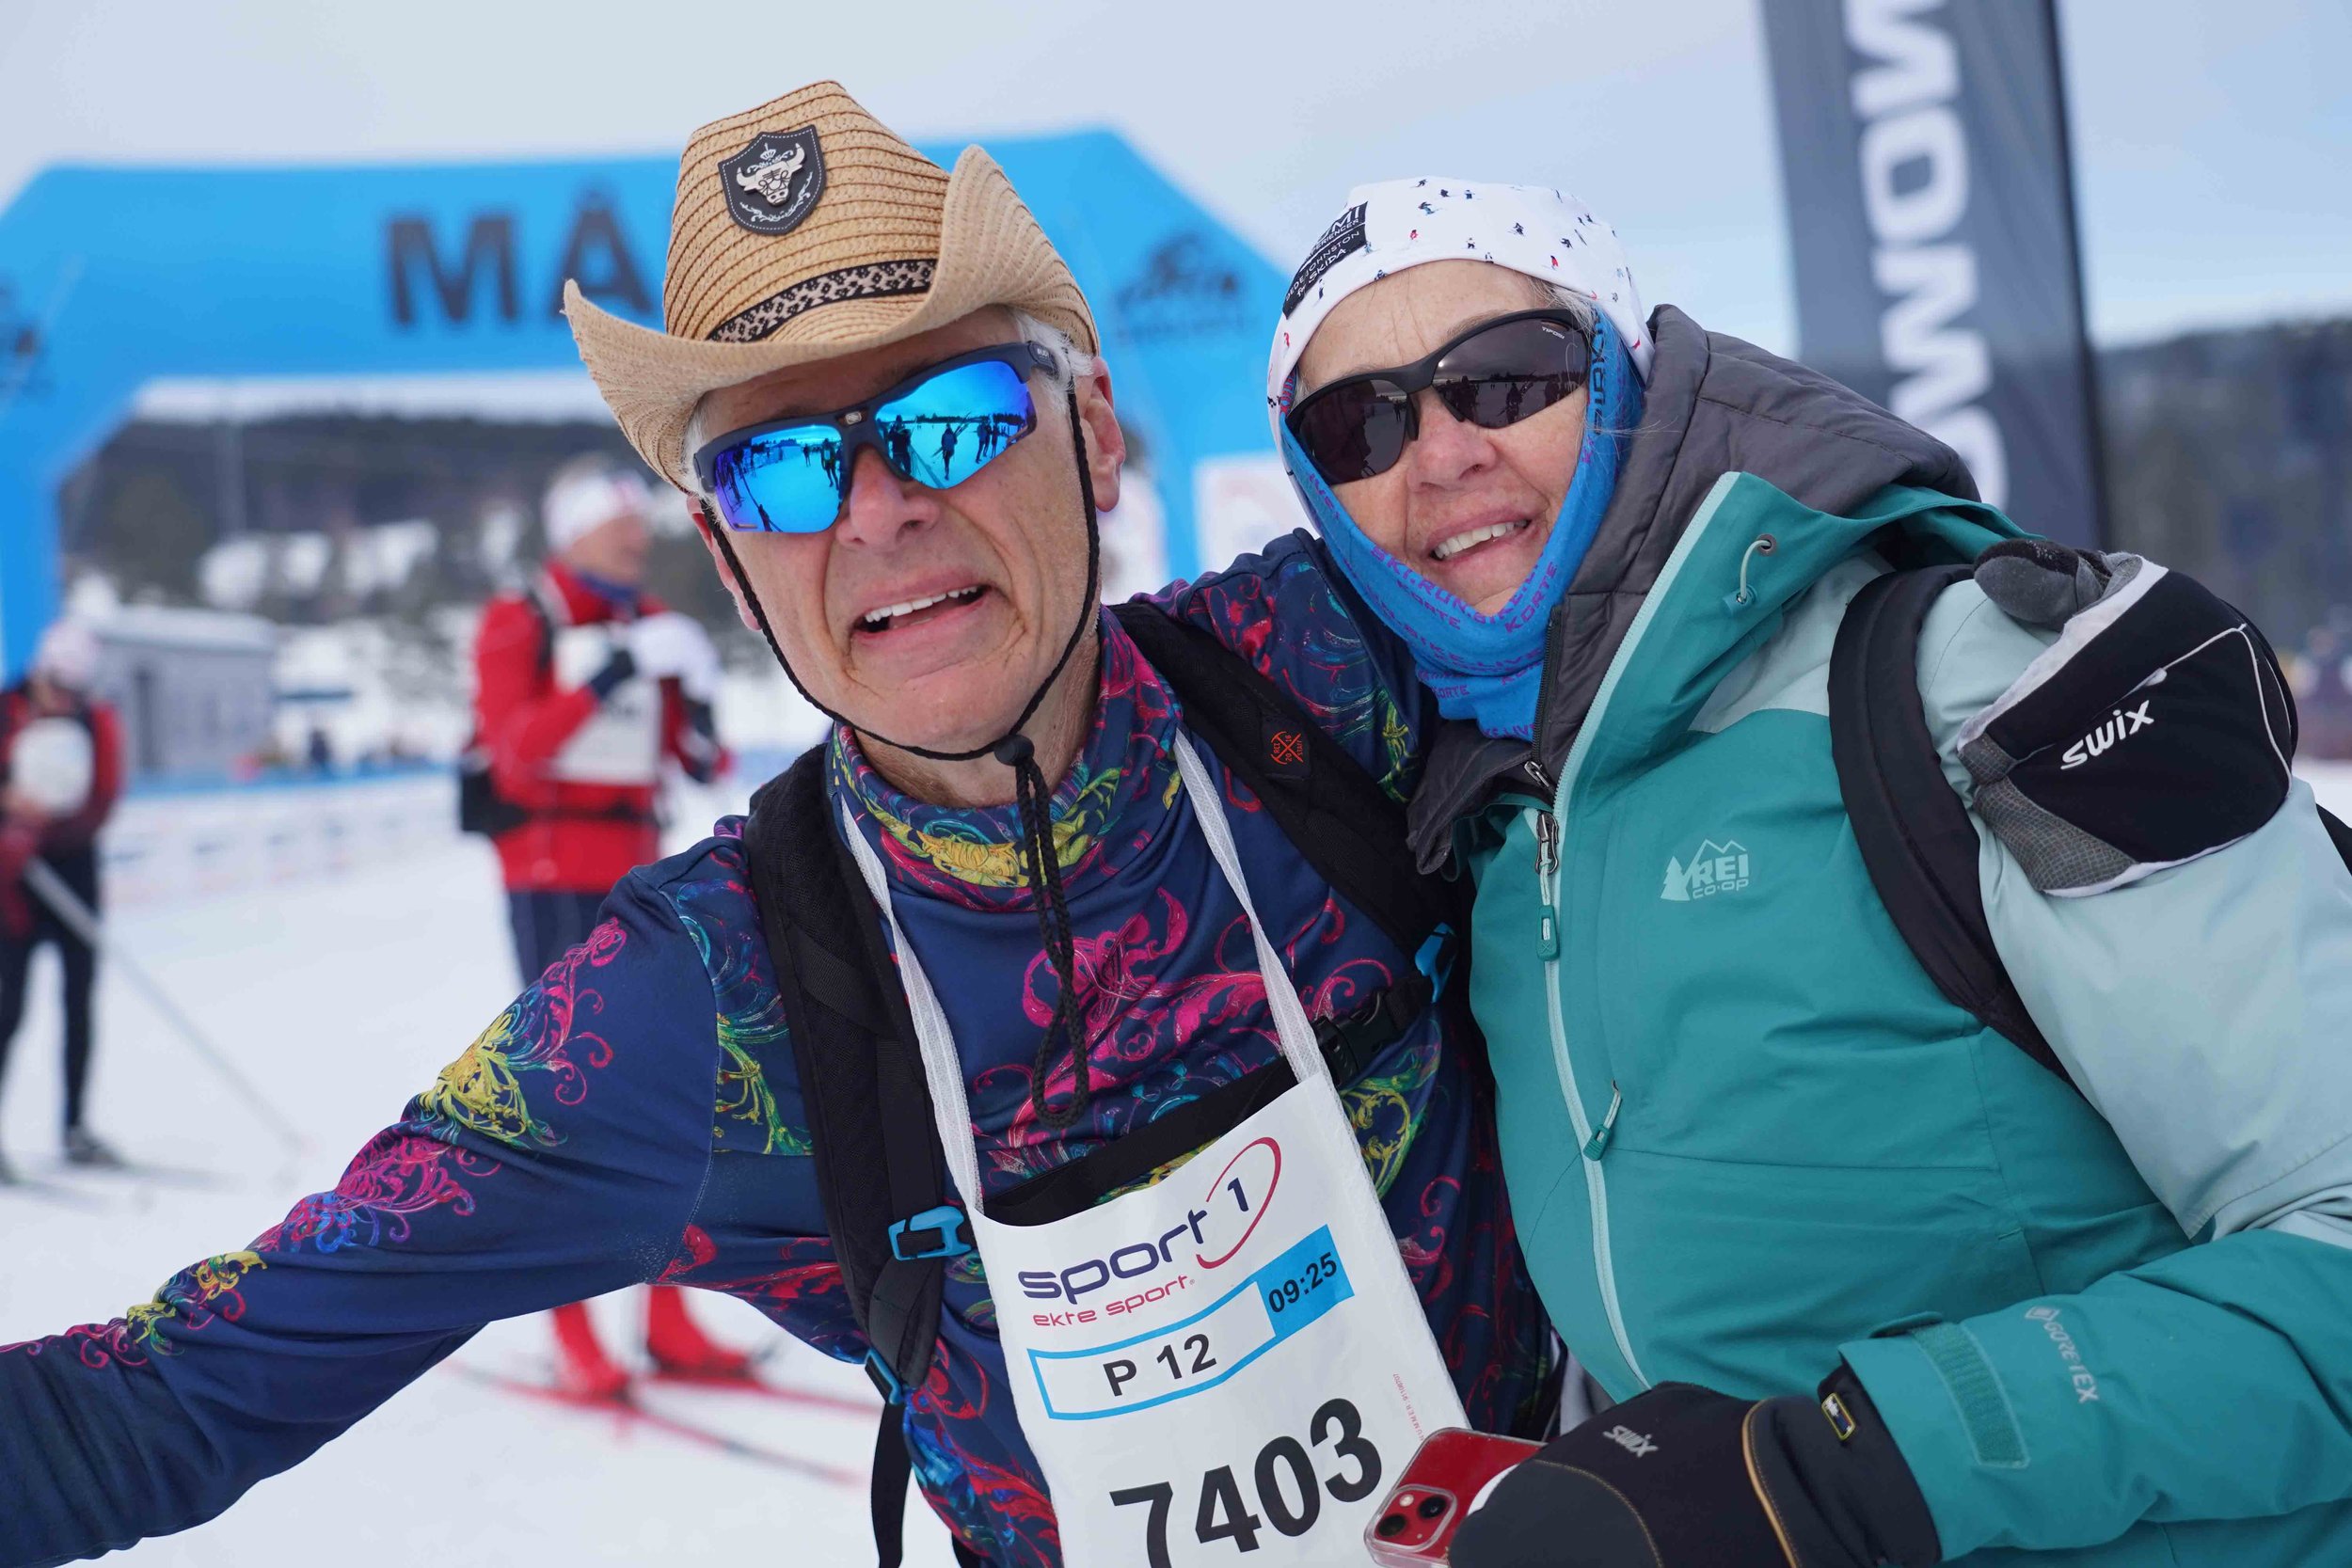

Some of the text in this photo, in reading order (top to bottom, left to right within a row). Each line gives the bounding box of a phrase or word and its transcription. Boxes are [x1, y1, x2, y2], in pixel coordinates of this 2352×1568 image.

[1308, 248, 1346, 284] SKIDA
[1505, 562, 1558, 633] KORTE
[1693, 853, 1749, 887] REI
[1018, 1177, 1250, 1306] sport 1
[1268, 1252, 1338, 1313] 09:25
[1032, 1307, 1098, 1327] ekte
[1103, 1333, 1217, 1397] P 12
[1109, 1398, 1382, 1568] 7403
